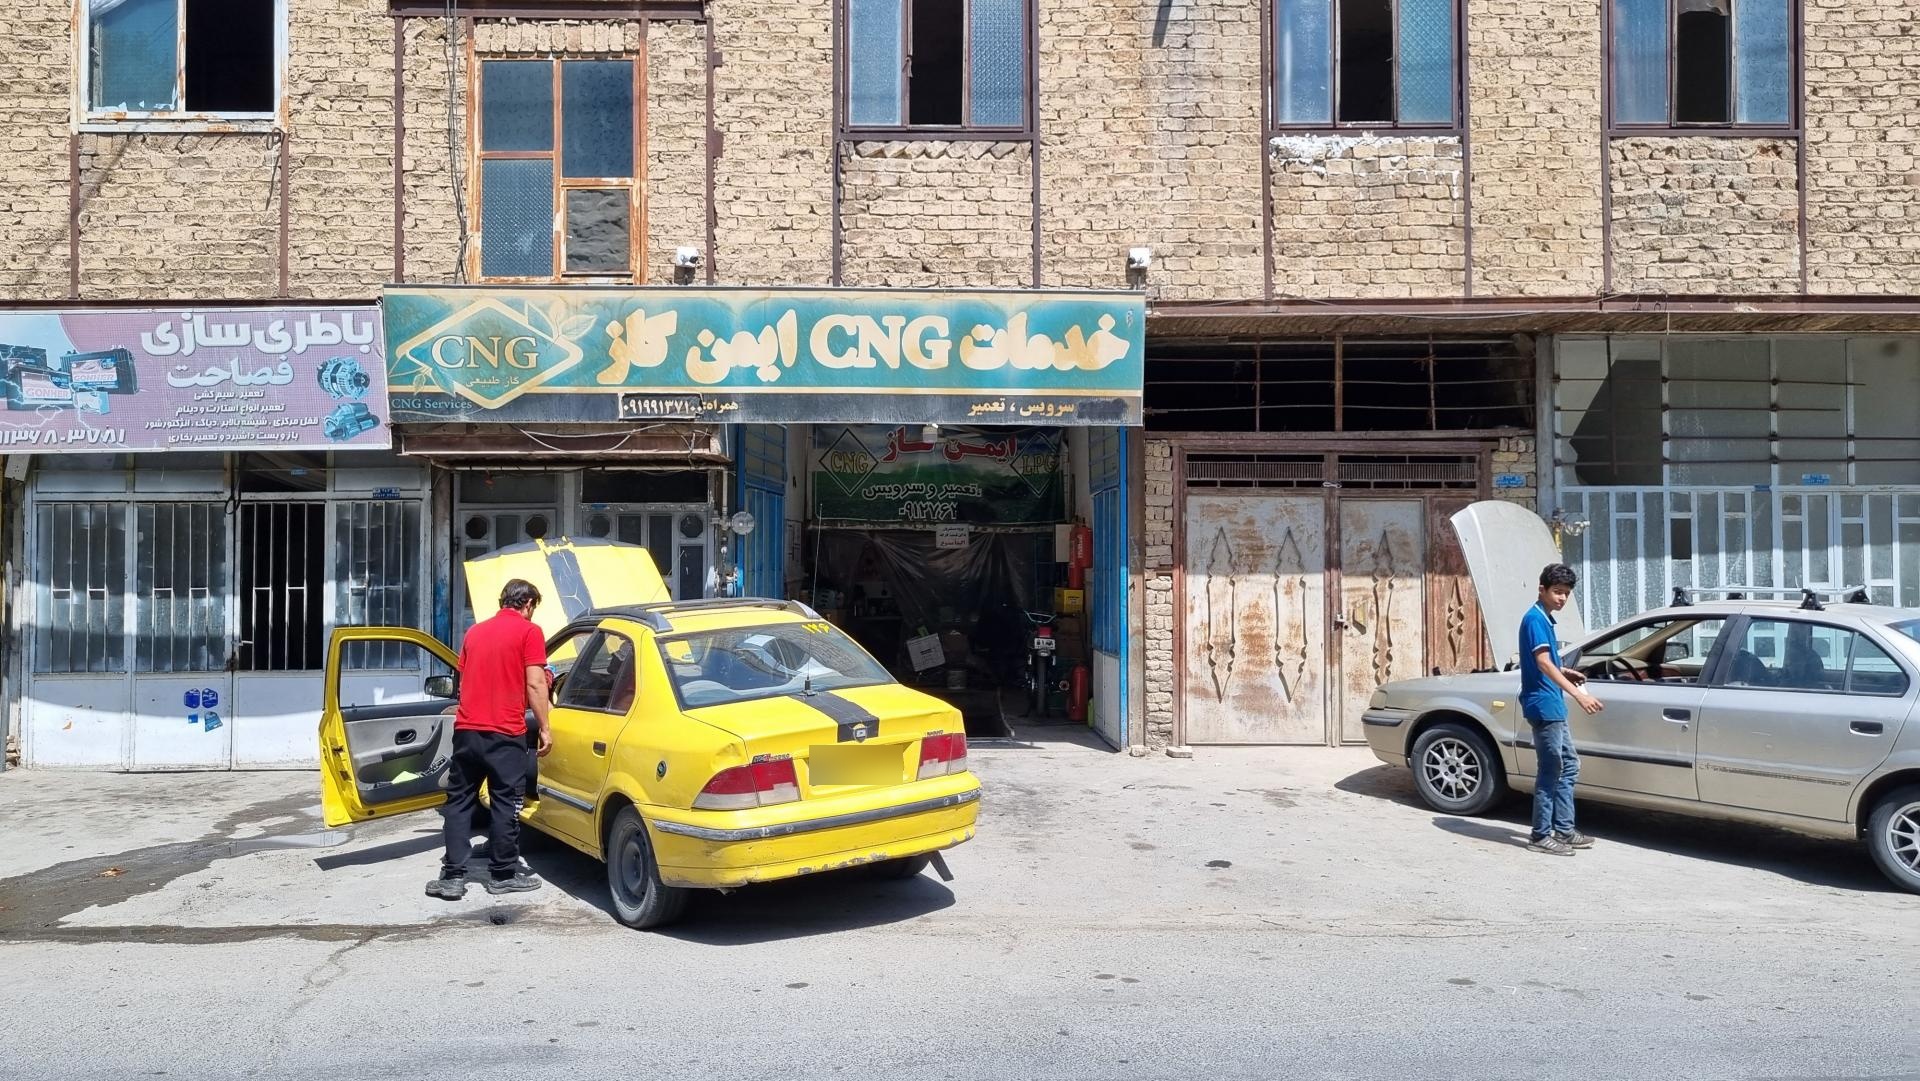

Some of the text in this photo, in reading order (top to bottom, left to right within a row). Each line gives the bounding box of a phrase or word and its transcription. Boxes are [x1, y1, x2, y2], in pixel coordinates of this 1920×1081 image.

[141, 312, 374, 356] باطری سازی
[810, 314, 952, 370] CNG
[960, 312, 1130, 371] خدمات
[431, 335, 539, 370] CNG
[685, 308, 798, 384] ایمن
[166, 356, 295, 388] فصاحت
[240, 389, 265, 400] تعمیر
[206, 404, 239, 414] استارت
[240, 404, 260, 416] انواع
[261, 404, 286, 414] تعمیر
[391, 398, 473, 409] CNG Services
[967, 397, 1006, 416] تعمیر
[1020, 401, 1075, 417] سرویس
[273, 416, 299, 427] مرکزی
[300, 416, 319, 427] قفل
[195, 432, 218, 443] تعمیر
[943, 433, 1018, 465] ایمن
[830, 451, 869, 475] CNG
